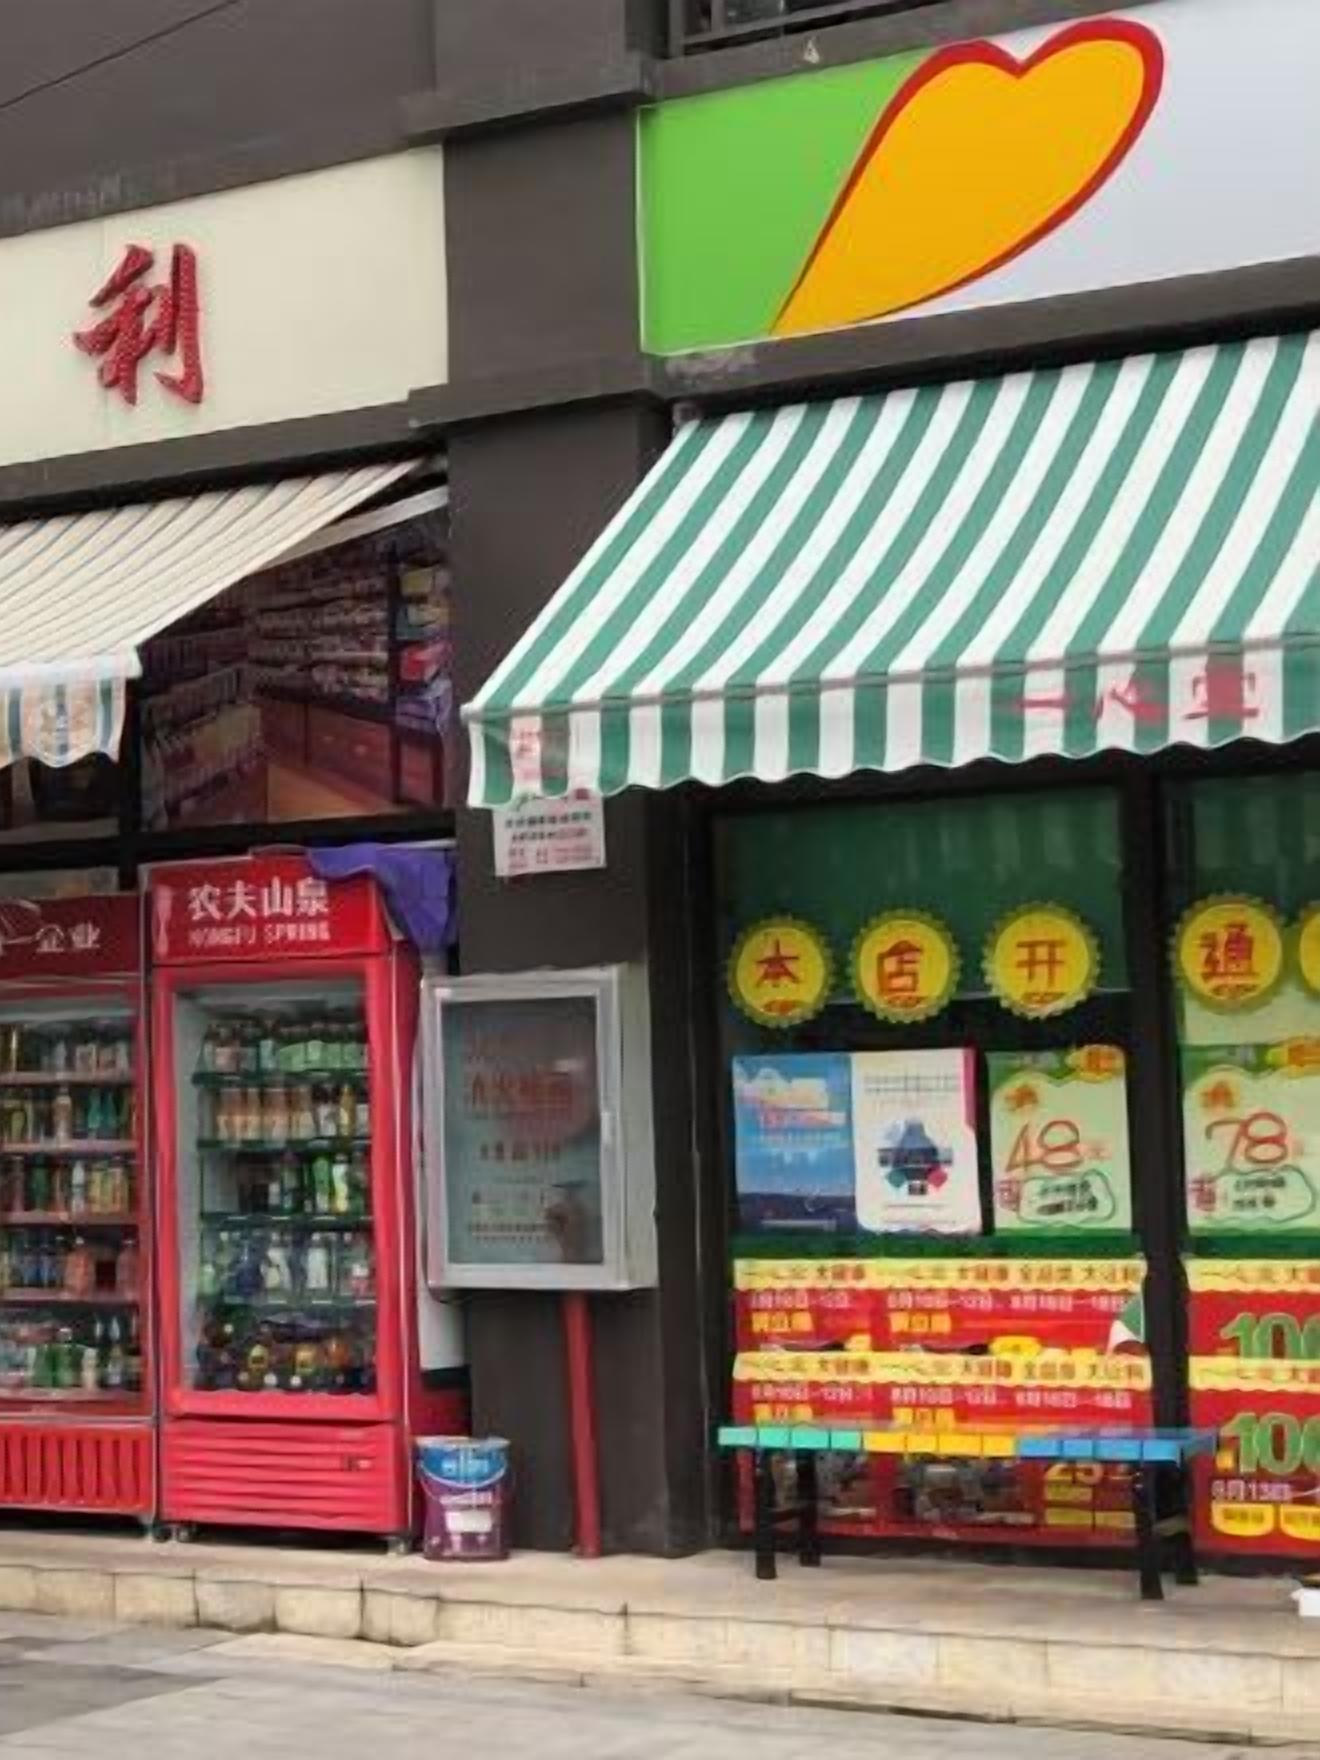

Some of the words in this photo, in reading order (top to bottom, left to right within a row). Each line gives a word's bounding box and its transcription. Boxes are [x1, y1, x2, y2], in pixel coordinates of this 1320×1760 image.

[188, 876, 329, 921] 农夫山泉
[1005, 1118, 1082, 1174] 48
[1205, 1112, 1289, 1170] 78
